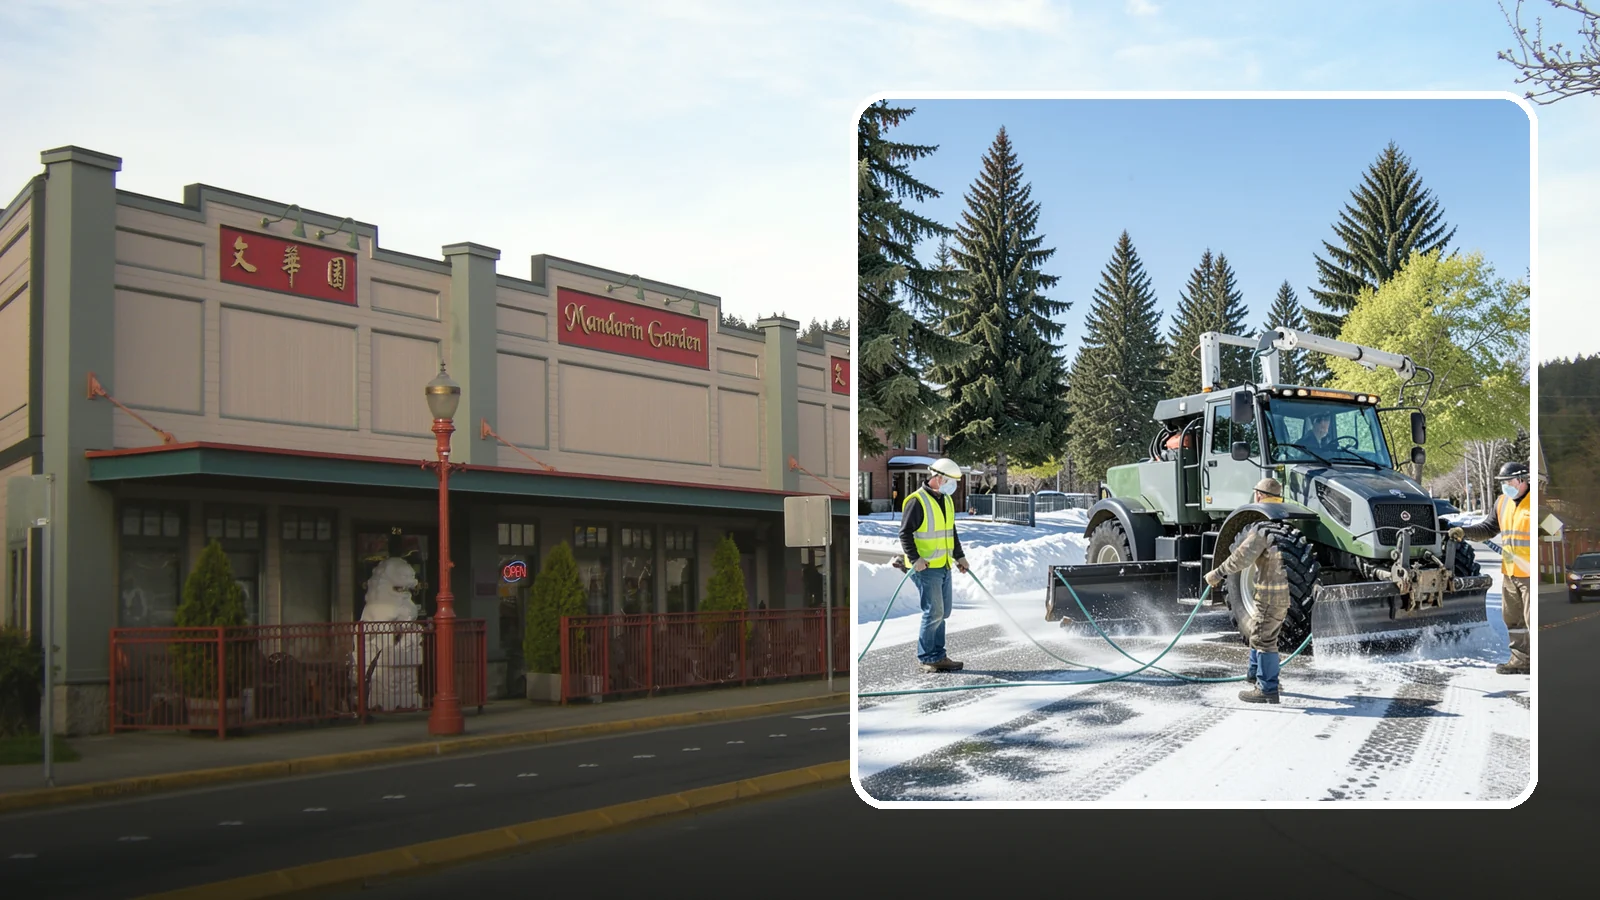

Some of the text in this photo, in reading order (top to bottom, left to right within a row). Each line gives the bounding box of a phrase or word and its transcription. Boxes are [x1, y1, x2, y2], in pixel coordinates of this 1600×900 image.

[564, 302, 702, 352] Mandarin Garden
[503, 565, 527, 578] OPEN
